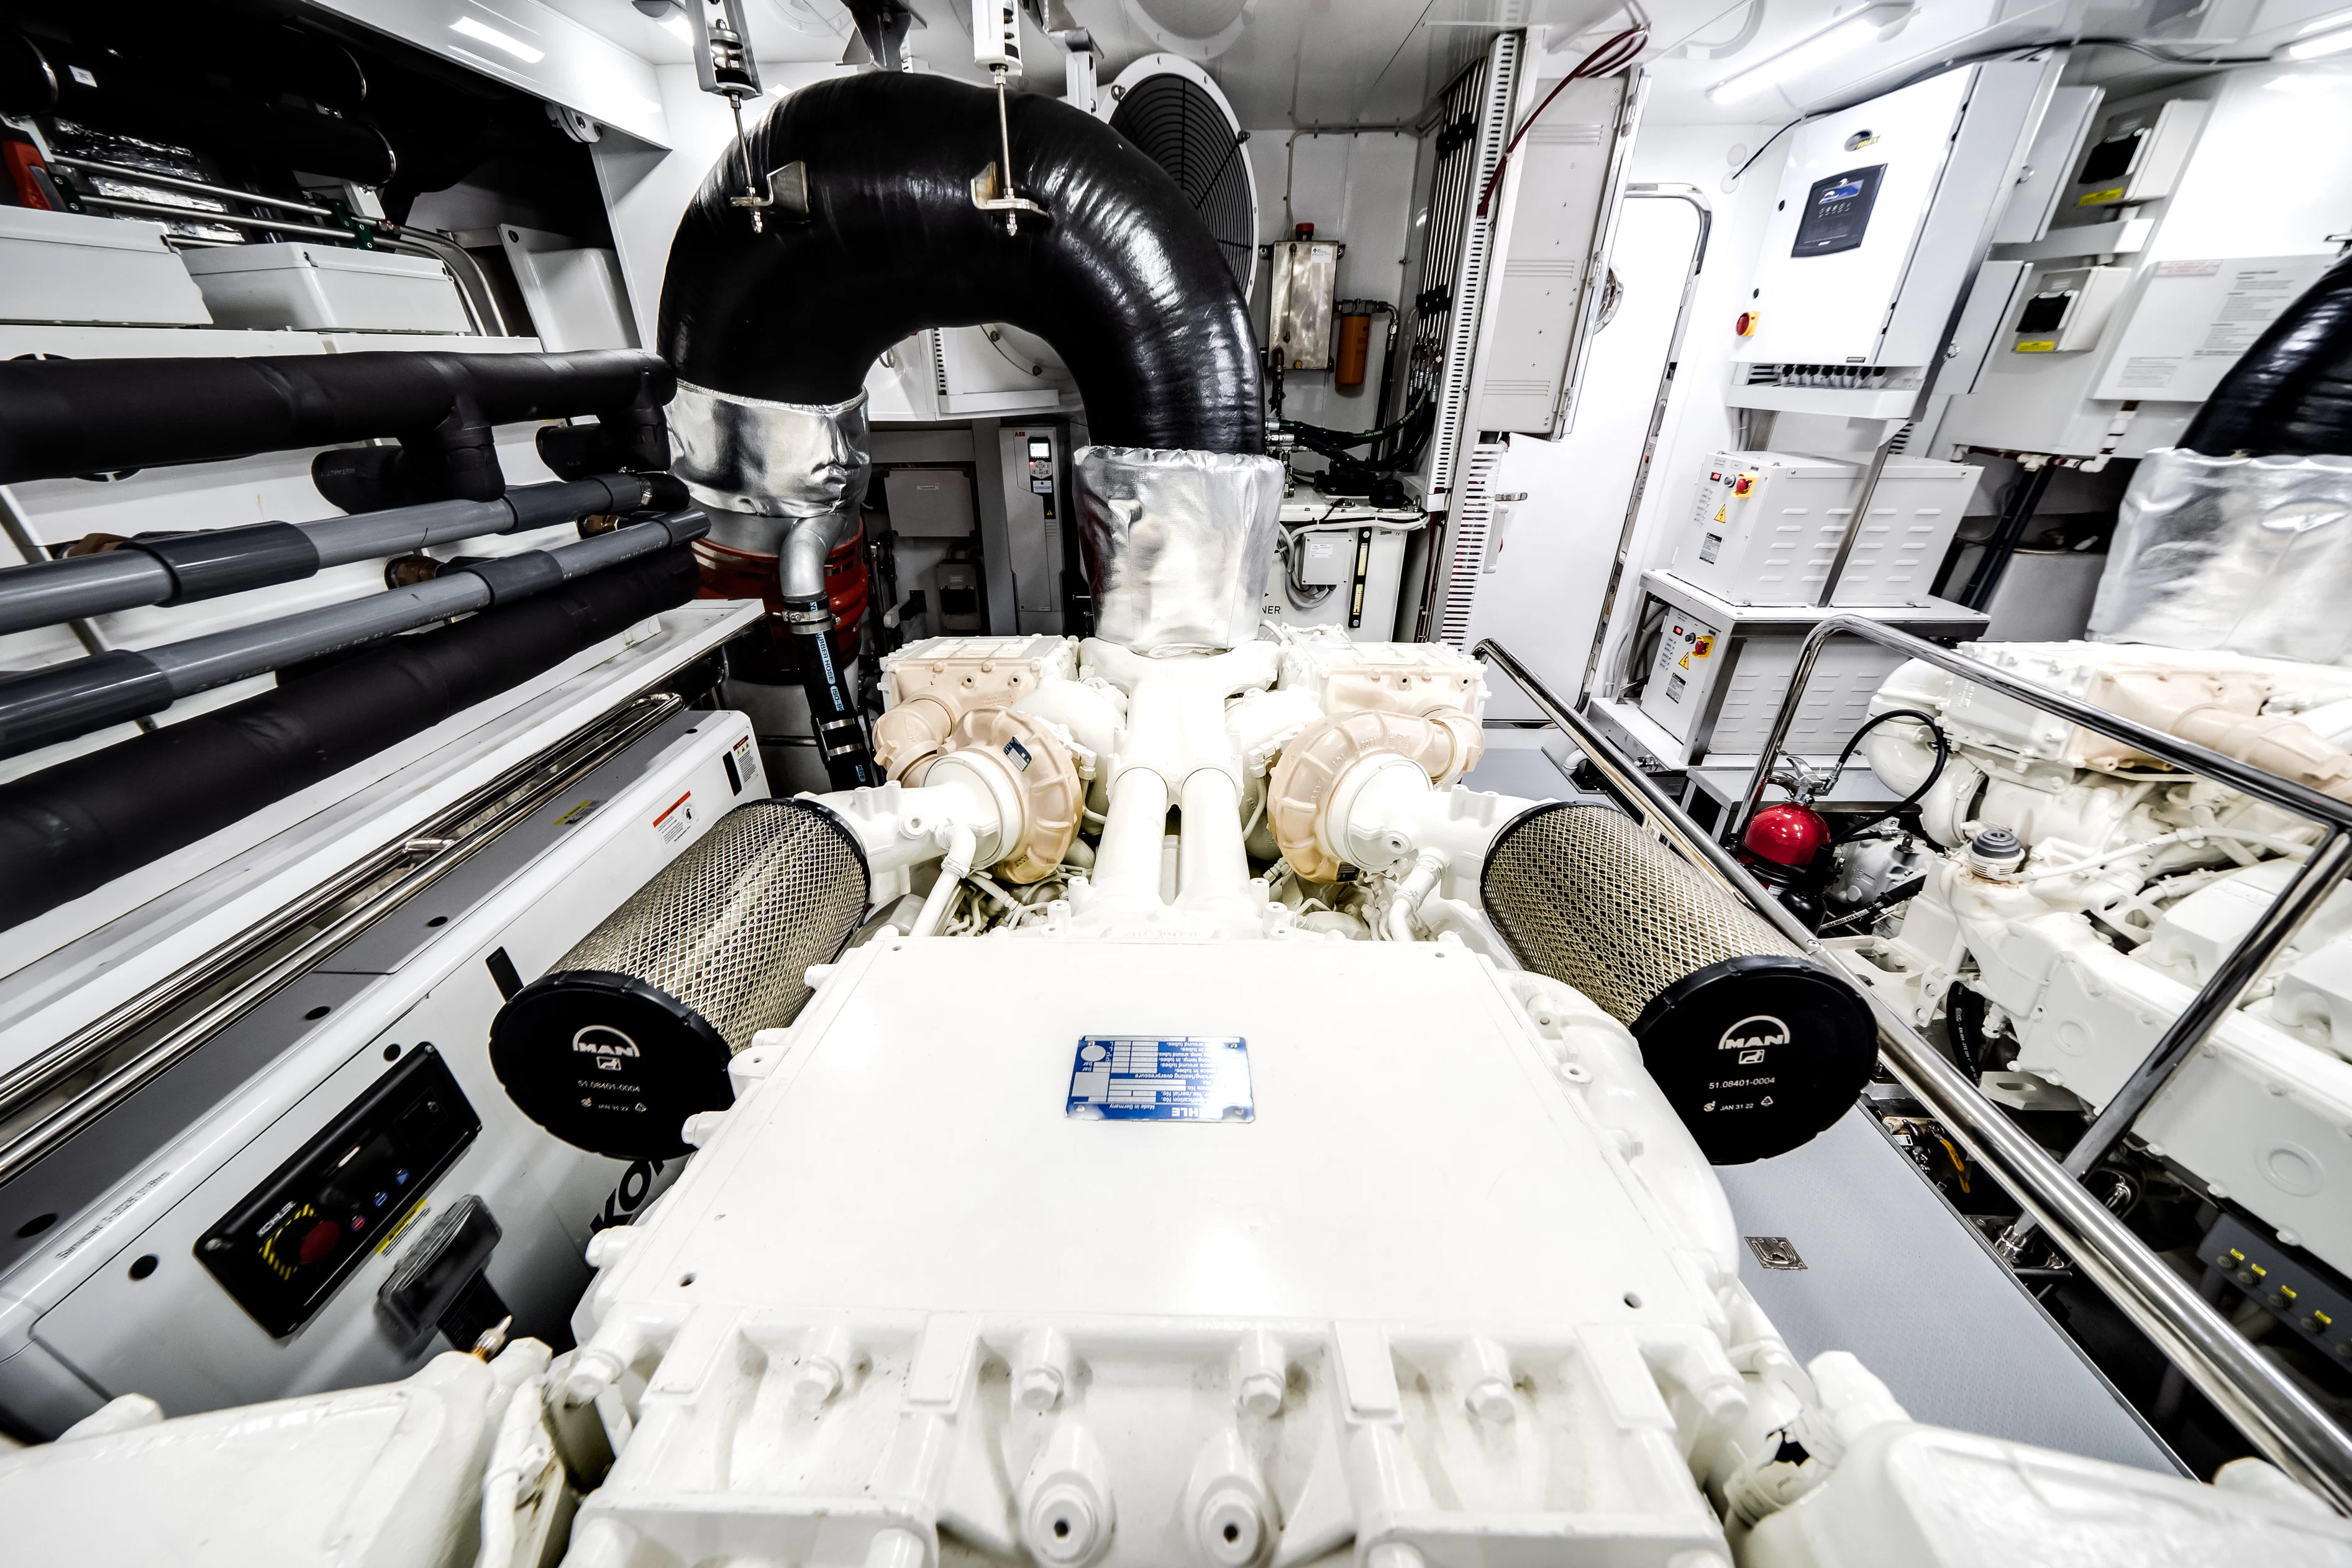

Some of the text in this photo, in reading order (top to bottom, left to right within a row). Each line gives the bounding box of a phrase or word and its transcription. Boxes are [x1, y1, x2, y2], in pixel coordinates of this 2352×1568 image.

[824, 659, 834, 682] HOSE
[1725, 1034, 1784, 1049] MAN
[578, 1042, 634, 1057] MAN
[1708, 1077, 1775, 1089] 51.08401-0004
[256, 1200, 298, 1238] KOHLER
